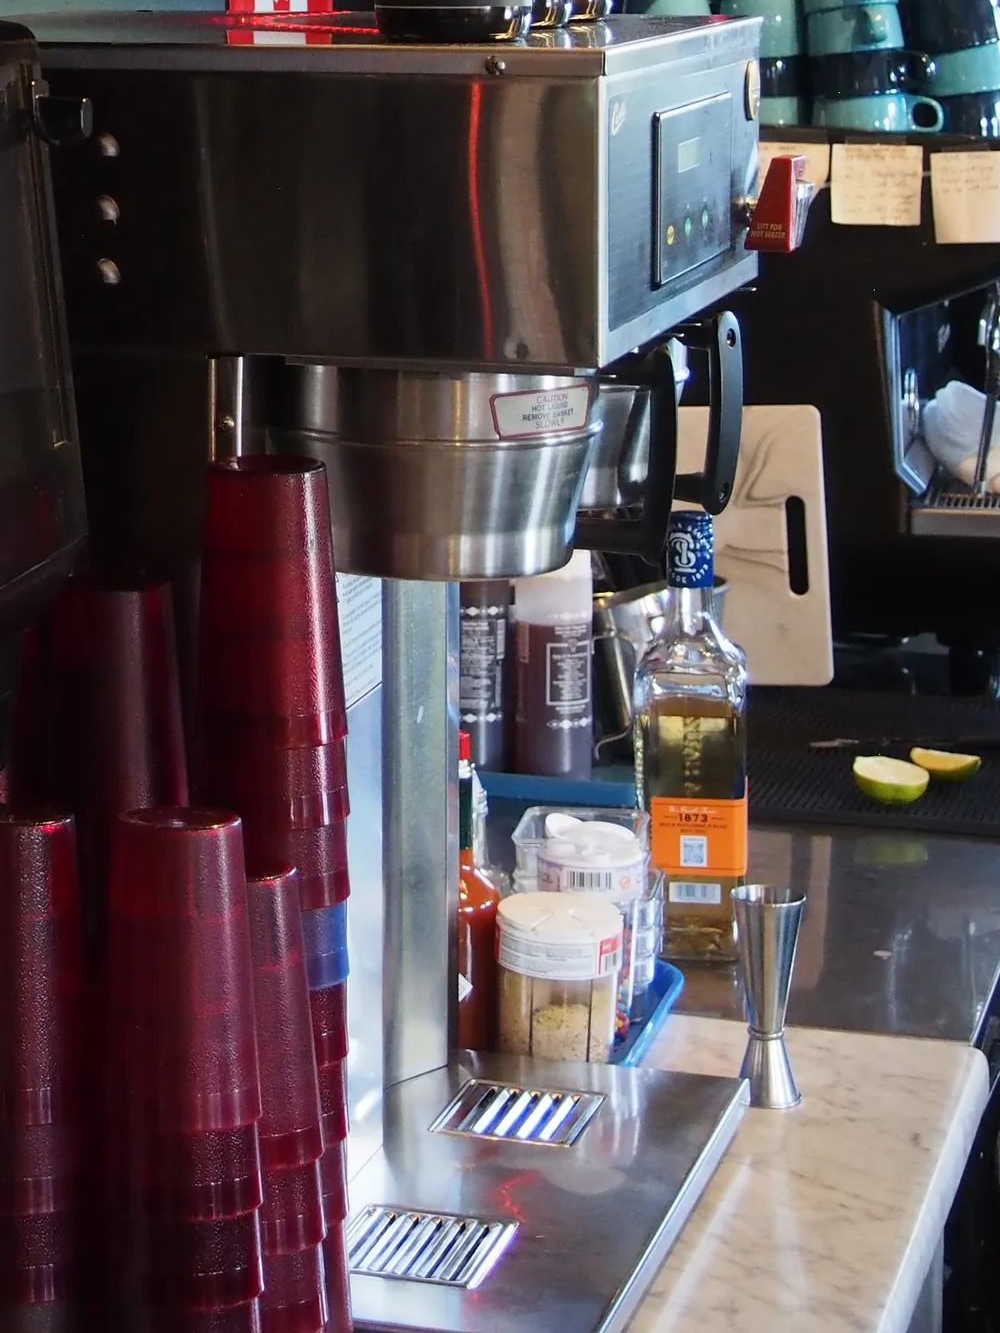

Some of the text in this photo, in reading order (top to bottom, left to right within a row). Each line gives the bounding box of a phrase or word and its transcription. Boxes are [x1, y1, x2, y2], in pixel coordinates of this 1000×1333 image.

[537, 393, 568, 404] CAUTION
[531, 402, 568, 413] HOT LIQUID
[522, 408, 574, 422] REMOVE BASKET
[535, 418, 565, 429] SLOWLY
[679, 813, 708, 823] 1873
